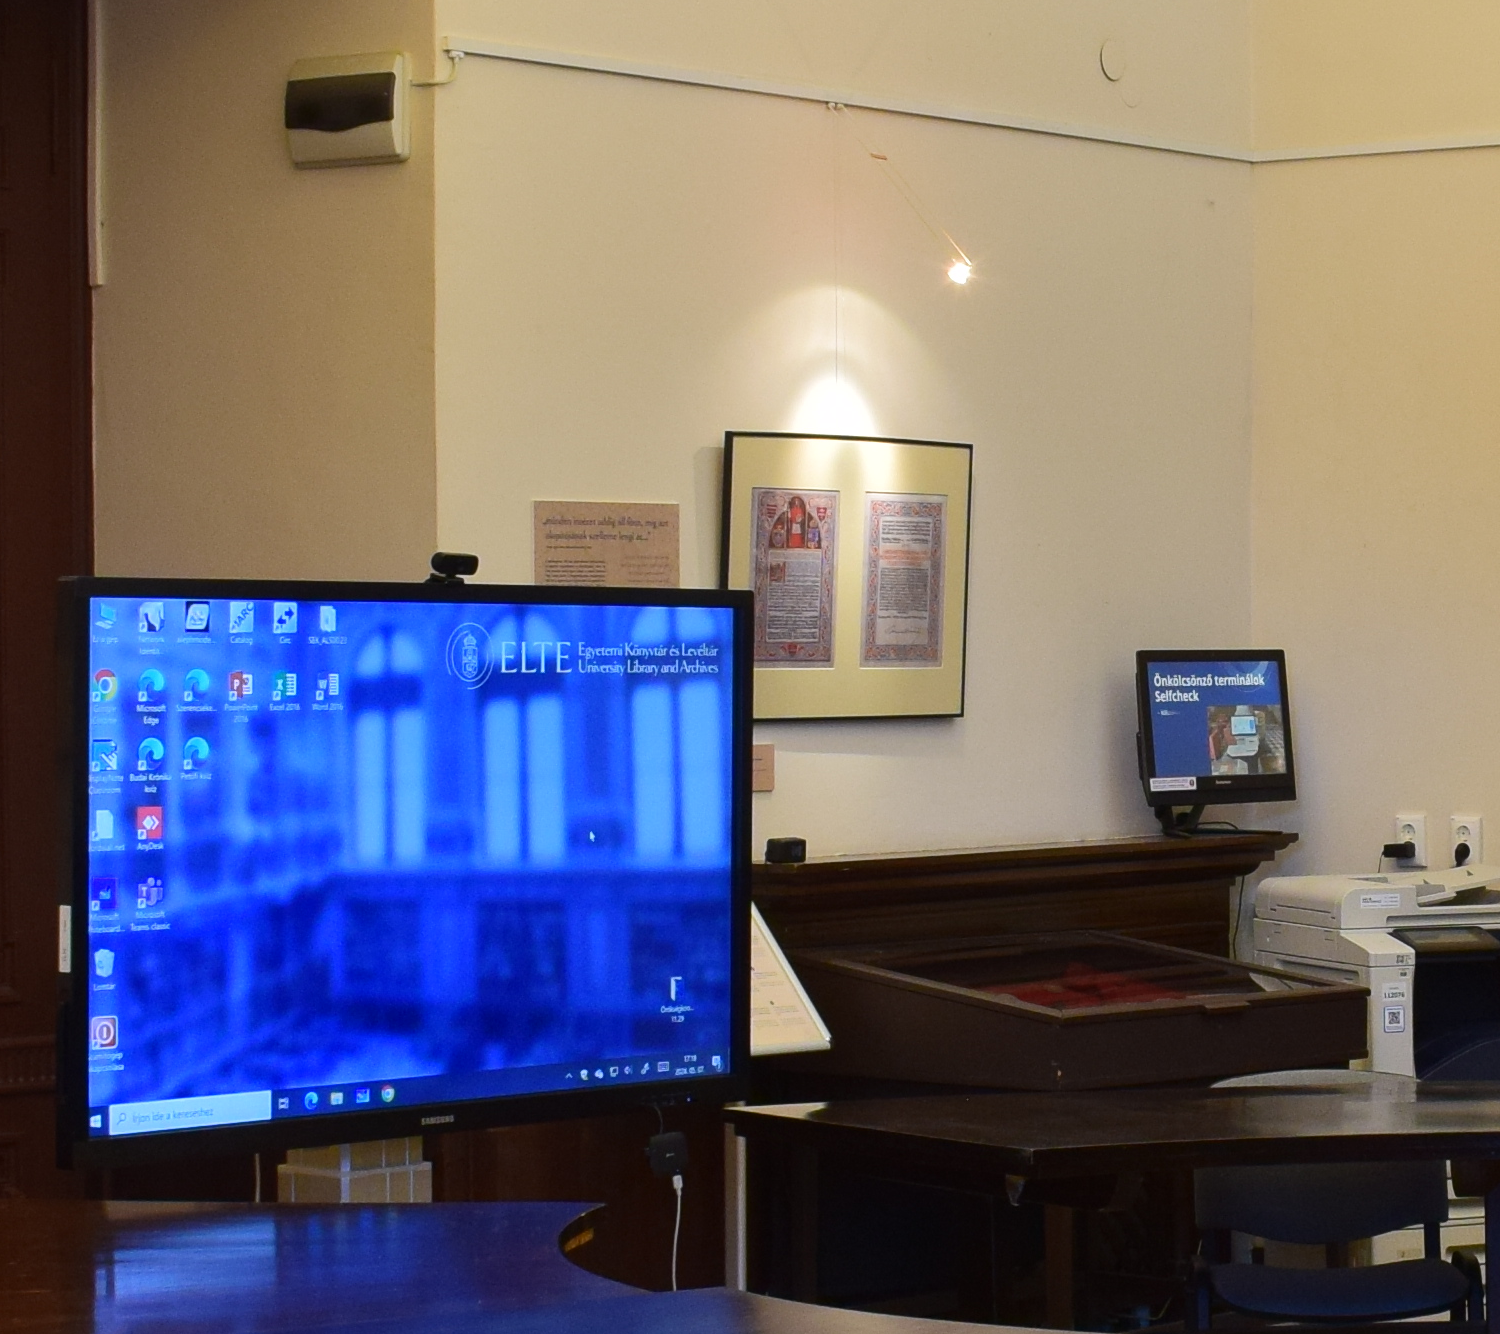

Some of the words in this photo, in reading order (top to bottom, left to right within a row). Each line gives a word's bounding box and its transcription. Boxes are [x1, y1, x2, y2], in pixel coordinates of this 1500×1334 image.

[501, 641, 572, 673] ELTE
[579, 642, 623, 659] Egyetemi
[625, 642, 667, 659] Könyvtár
[669, 643, 680, 657] és
[681, 643, 718, 657] Levéltár
[578, 660, 625, 676] University
[627, 660, 659, 676] Library
[661, 661, 679, 674] and
[680, 660, 719, 674] Archives
[1153, 673, 1212, 687] Önkölcsönző
[1214, 674, 1265, 686] terminálok
[1155, 690, 1200, 702] Selfcheck
